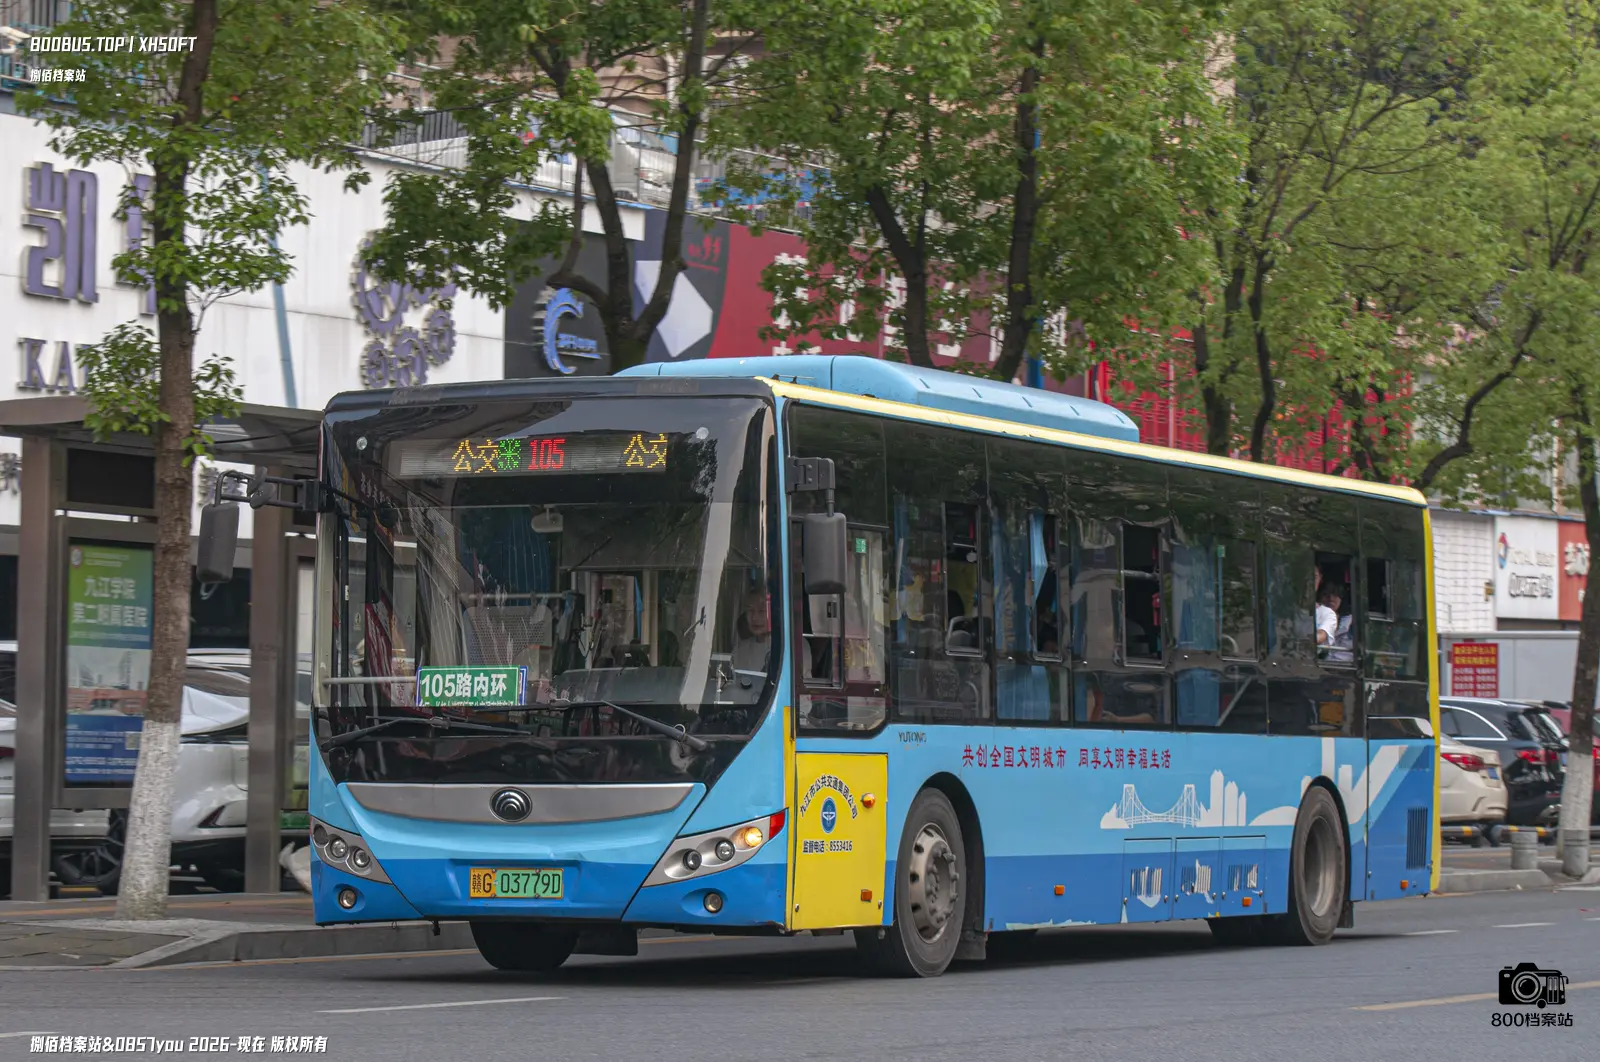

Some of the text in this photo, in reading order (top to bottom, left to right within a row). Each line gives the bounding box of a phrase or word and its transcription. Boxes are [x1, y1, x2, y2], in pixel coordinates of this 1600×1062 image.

[451, 438, 499, 473] 公交
[527, 438, 566, 470] 105
[83, 576, 136, 600] 九江学院
[421, 672, 507, 698] 105路内环
[962, 744, 1171, 769] 共创全国文明城市 同享文明幸福生活
